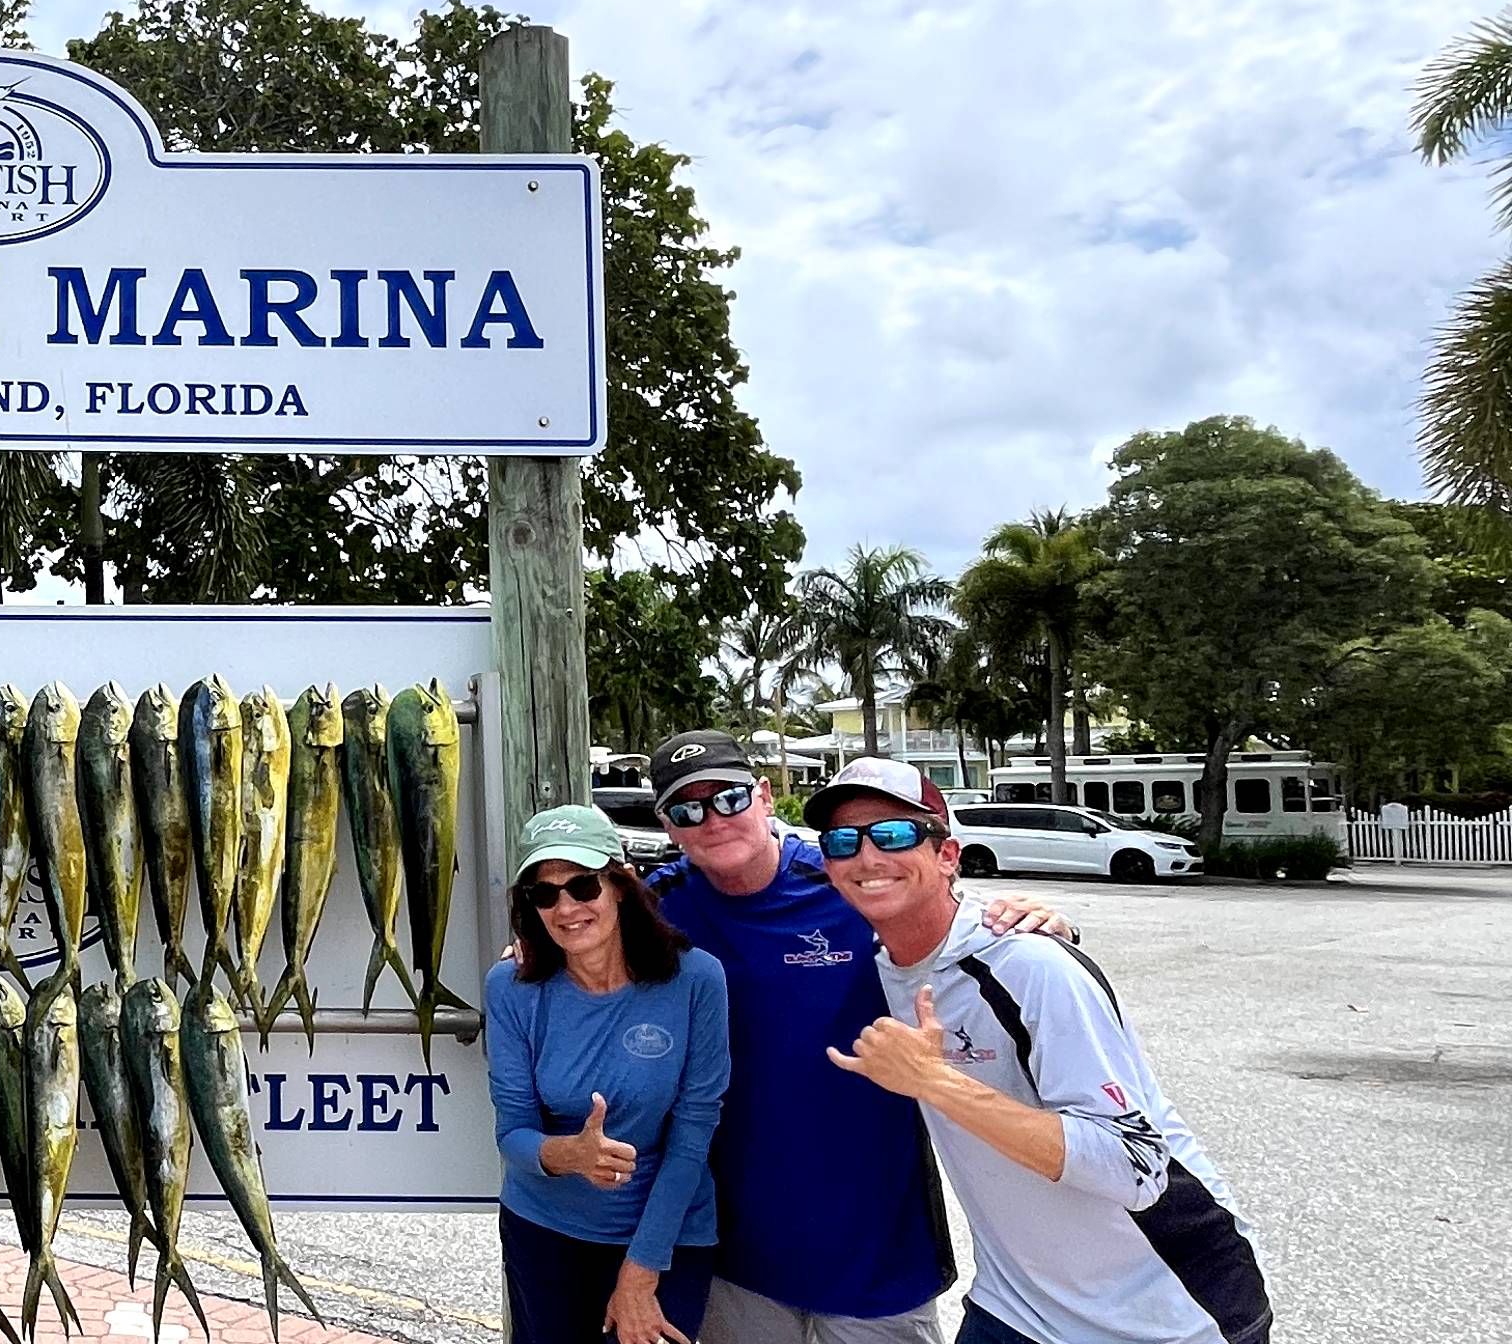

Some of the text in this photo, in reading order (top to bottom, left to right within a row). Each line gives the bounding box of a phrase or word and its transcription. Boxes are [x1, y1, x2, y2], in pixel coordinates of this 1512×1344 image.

[46, 266, 545, 349] MARINA
[85, 381, 310, 418] FLORIDA
[249, 1072, 452, 1132] LEET
